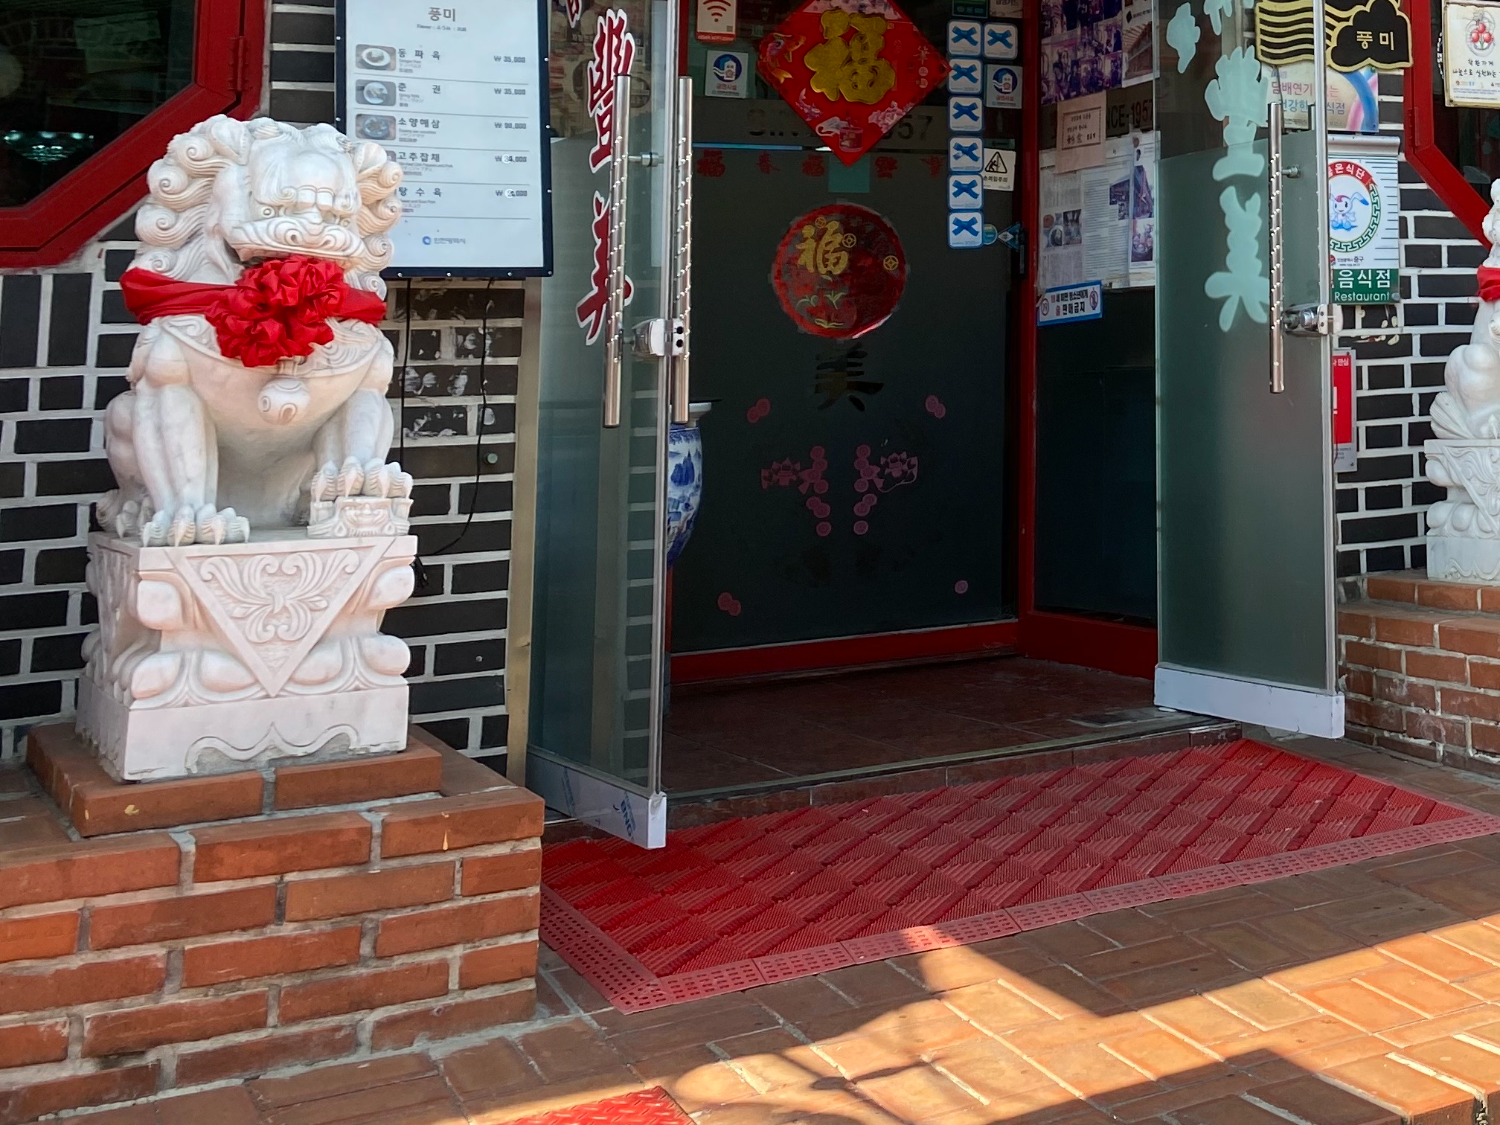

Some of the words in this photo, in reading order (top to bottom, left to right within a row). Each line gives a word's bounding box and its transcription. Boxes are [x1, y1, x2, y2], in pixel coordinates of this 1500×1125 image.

[428, 6, 456, 22] 풍미
[1356, 31, 1395, 51] 풍미
[1271, 82, 1313, 96] 담배연기
[398, 152, 441, 163] 고추잡채
[796, 220, 850, 276] 福
[1331, 269, 1390, 288] 음식점
[1334, 291, 1390, 301] Restaurant
